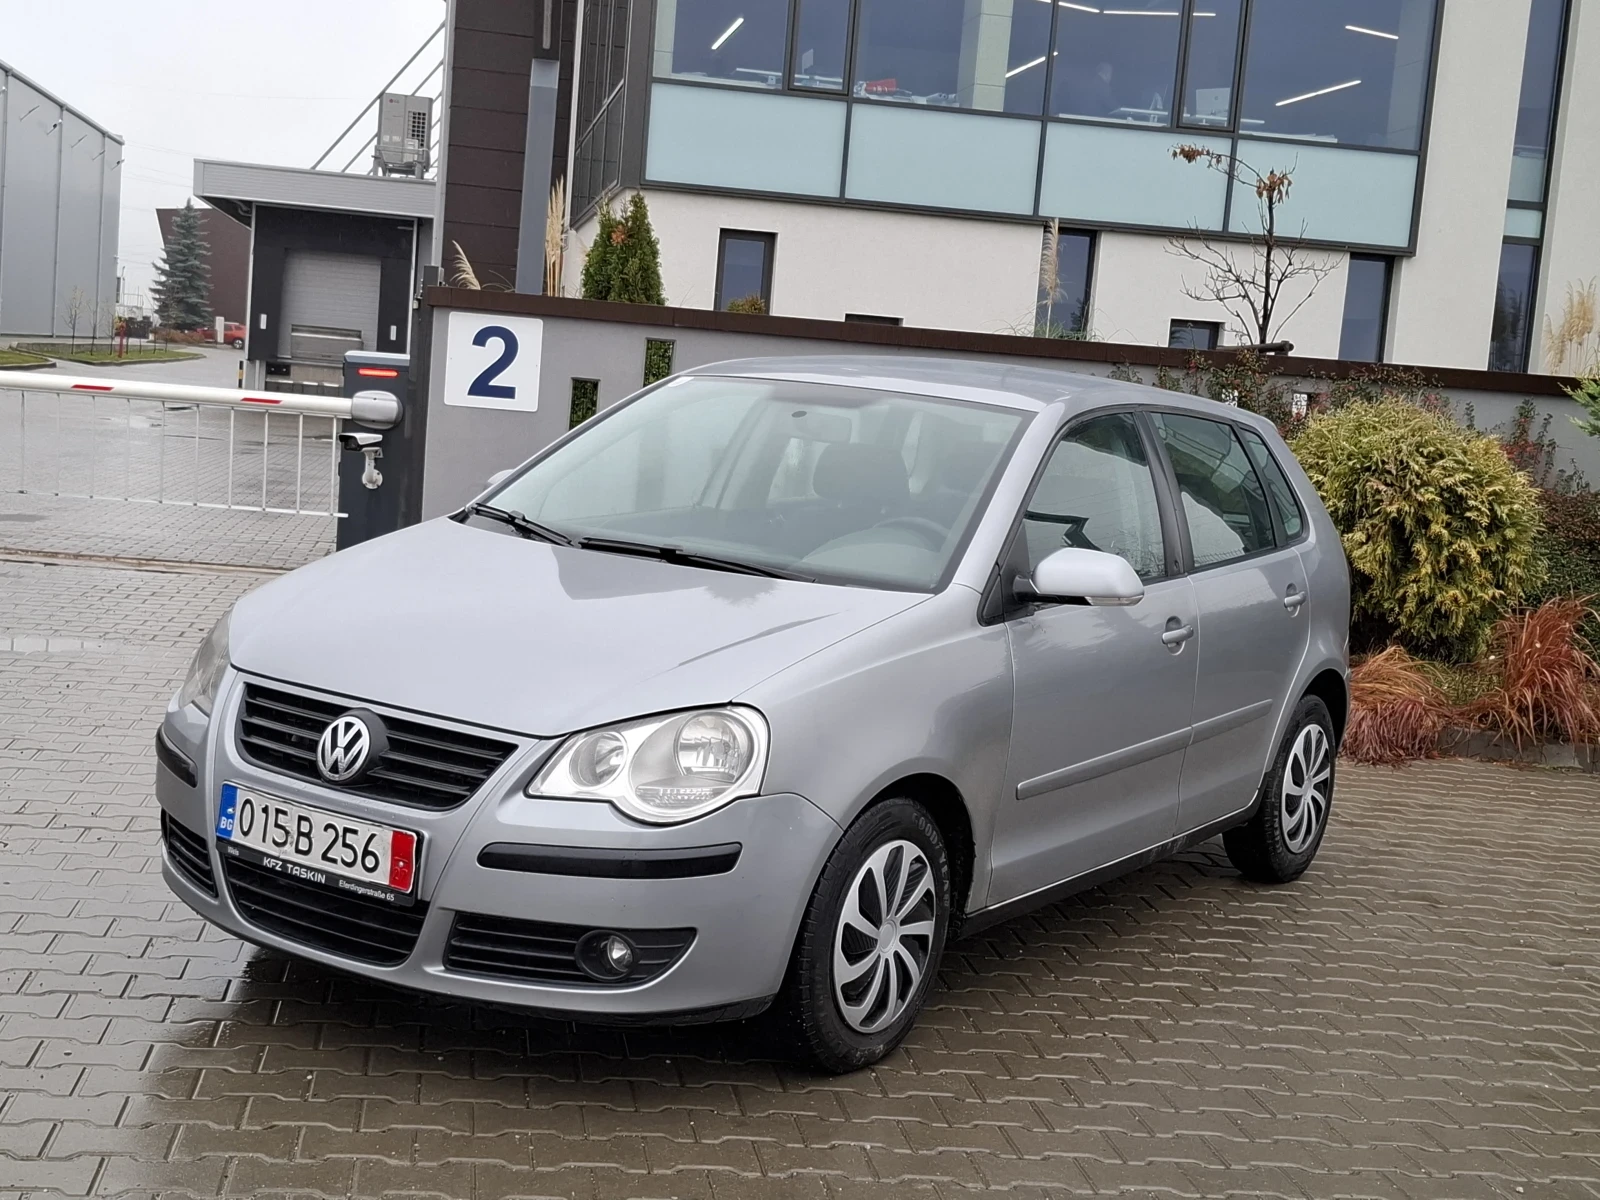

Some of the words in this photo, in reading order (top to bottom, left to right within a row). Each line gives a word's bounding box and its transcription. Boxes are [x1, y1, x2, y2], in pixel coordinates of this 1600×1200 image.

[467, 325, 519, 399] 2
[220, 816, 234, 831] BG
[263, 856, 283, 871] KFZ
[286, 863, 327, 884] TASKIN
[386, 893, 395, 901] 65
